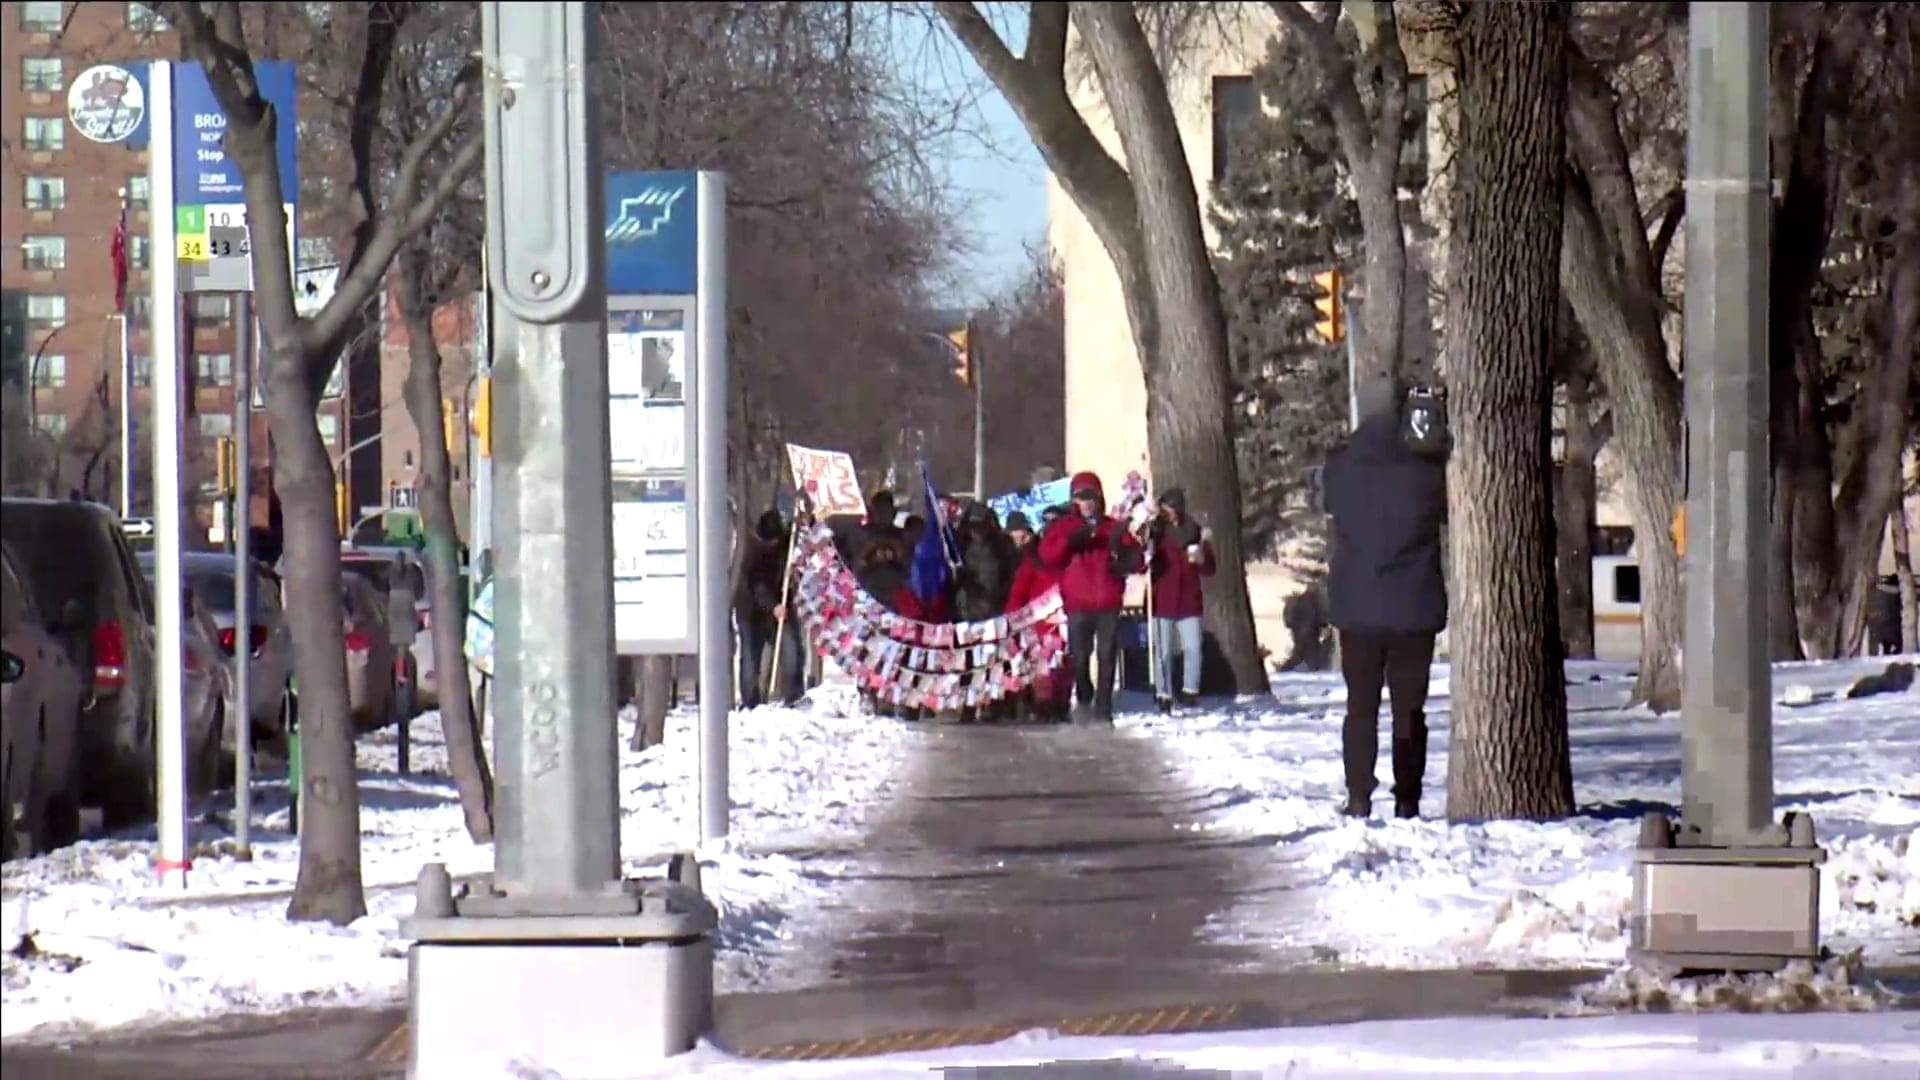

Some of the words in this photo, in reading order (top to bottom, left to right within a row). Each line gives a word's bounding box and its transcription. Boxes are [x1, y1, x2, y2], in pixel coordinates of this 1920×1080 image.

[197, 149, 224, 164] Stop
[186, 210, 195, 226] 1
[183, 242, 201, 256] 34
